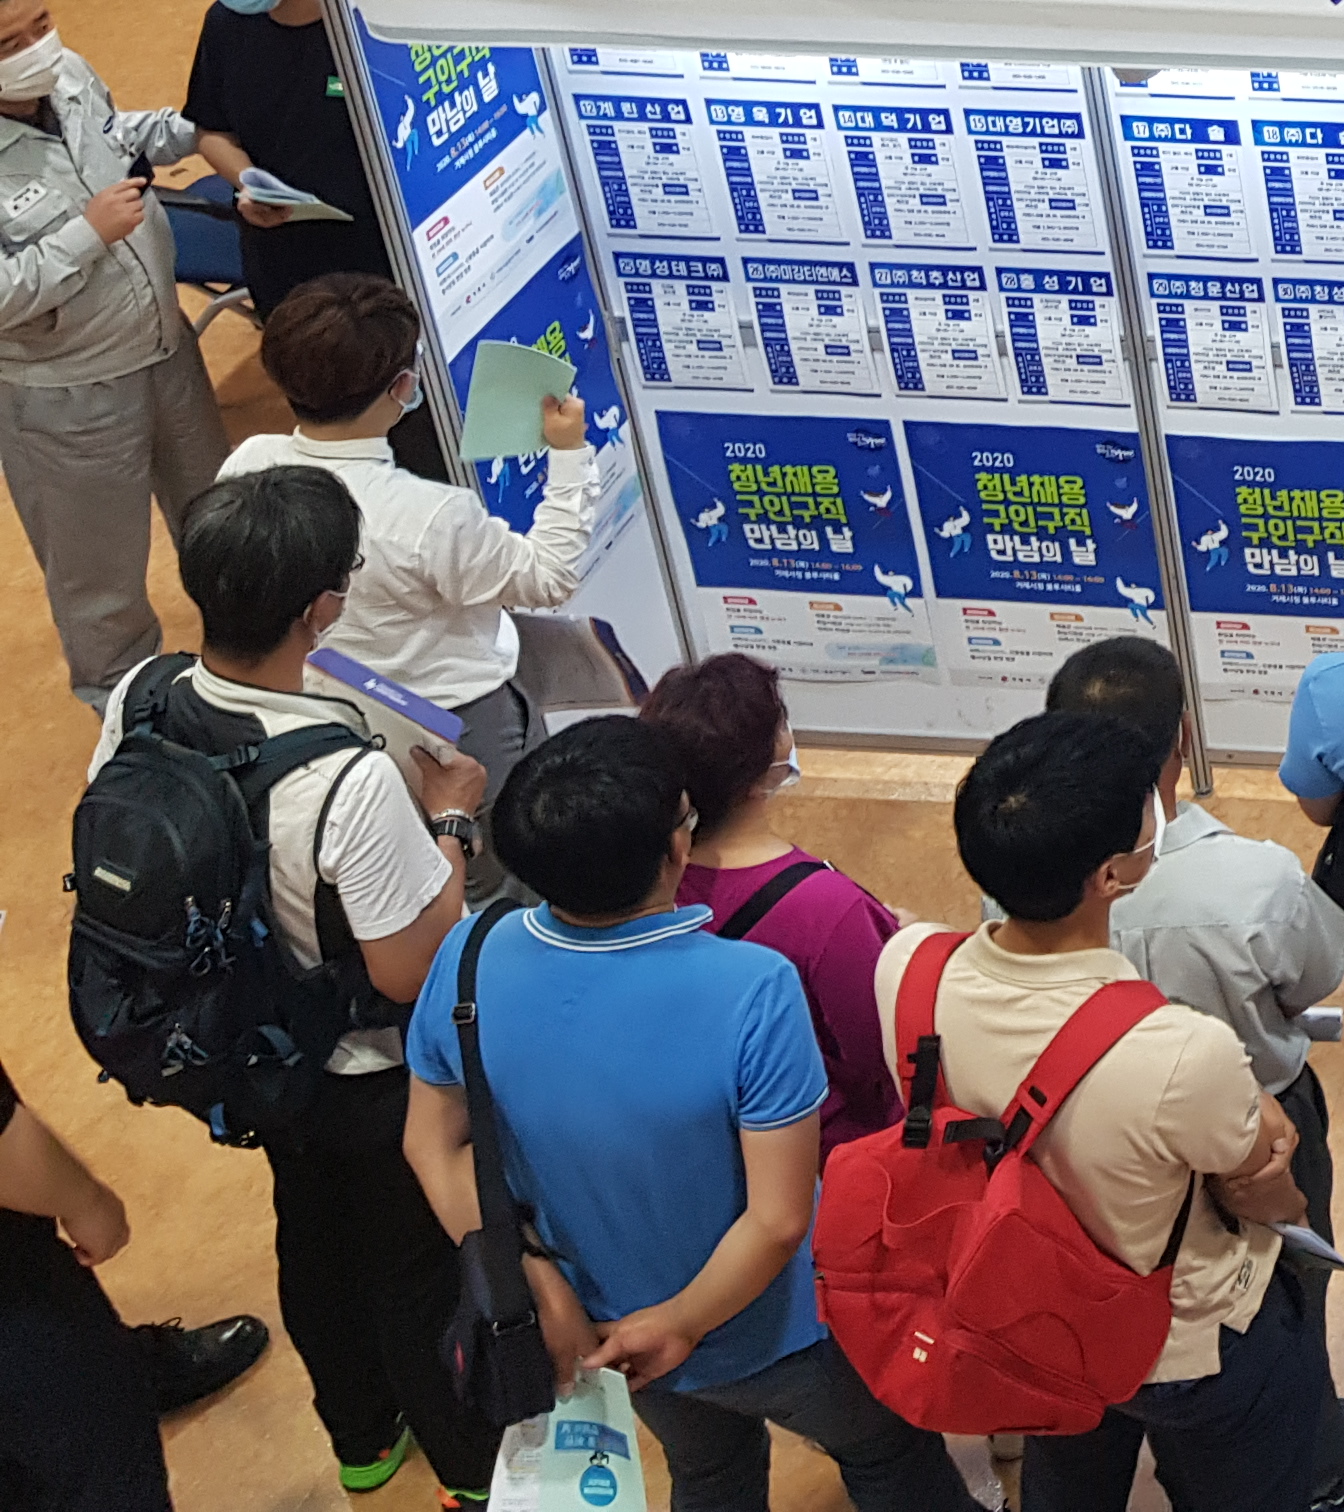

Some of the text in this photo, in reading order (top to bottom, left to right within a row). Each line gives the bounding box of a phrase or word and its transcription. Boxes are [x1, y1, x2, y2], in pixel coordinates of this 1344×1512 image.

[426, 61, 501, 148] 만남의 날
[724, 441, 767, 459] 2020
[972, 450, 1015, 468] 2020
[728, 462, 839, 495] 청년채용
[975, 471, 1086, 506] 청년채용
[1233, 465, 1276, 483] 2020
[736, 494, 848, 525] 구인구직
[982, 503, 1093, 536] 구인구직
[743, 523, 855, 555] 만남의 날
[986, 534, 1098, 566] 만남의 날
[1244, 548, 1321, 578] 만남의
